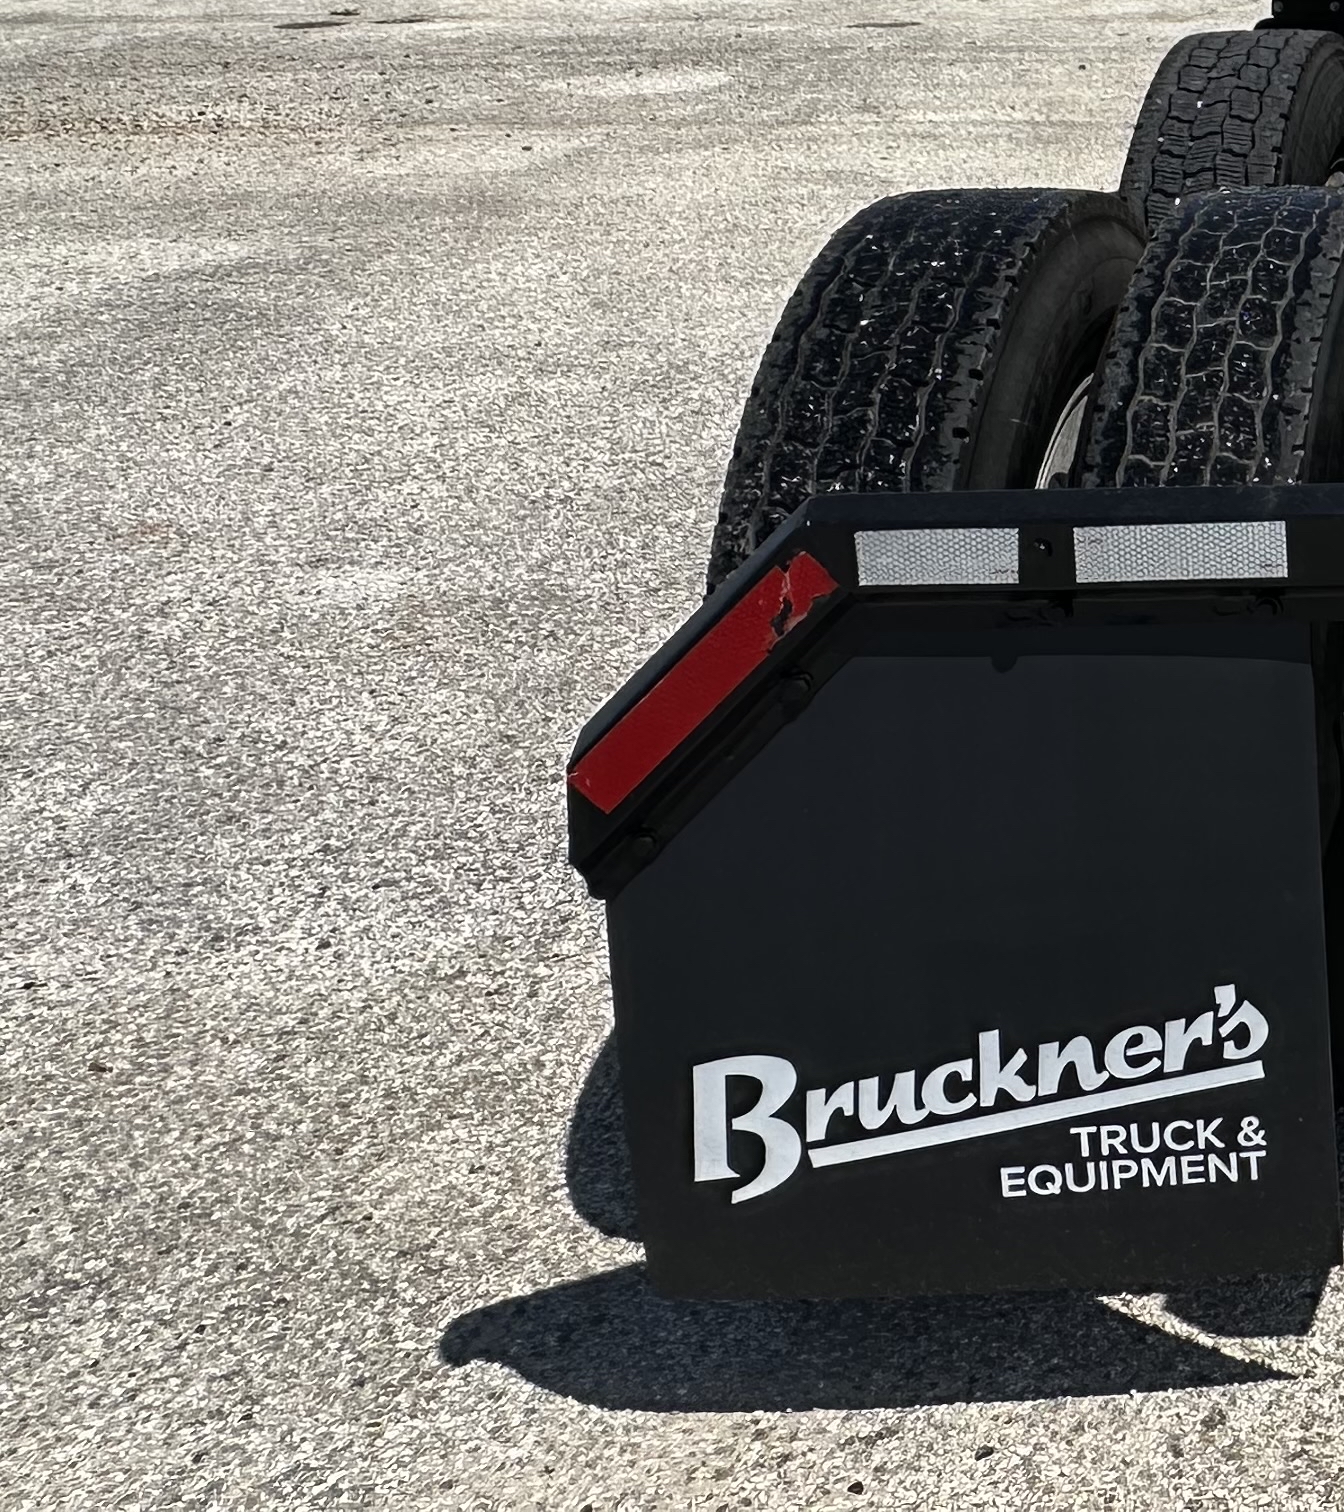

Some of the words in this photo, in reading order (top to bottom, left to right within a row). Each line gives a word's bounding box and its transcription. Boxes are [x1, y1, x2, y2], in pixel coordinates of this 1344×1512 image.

[692, 983, 1269, 1205] Bruckner's
[1069, 1117, 1226, 1158] TRUCK
[1236, 1115, 1268, 1147] &
[1000, 1149, 1267, 1198] EQUIPMENT
